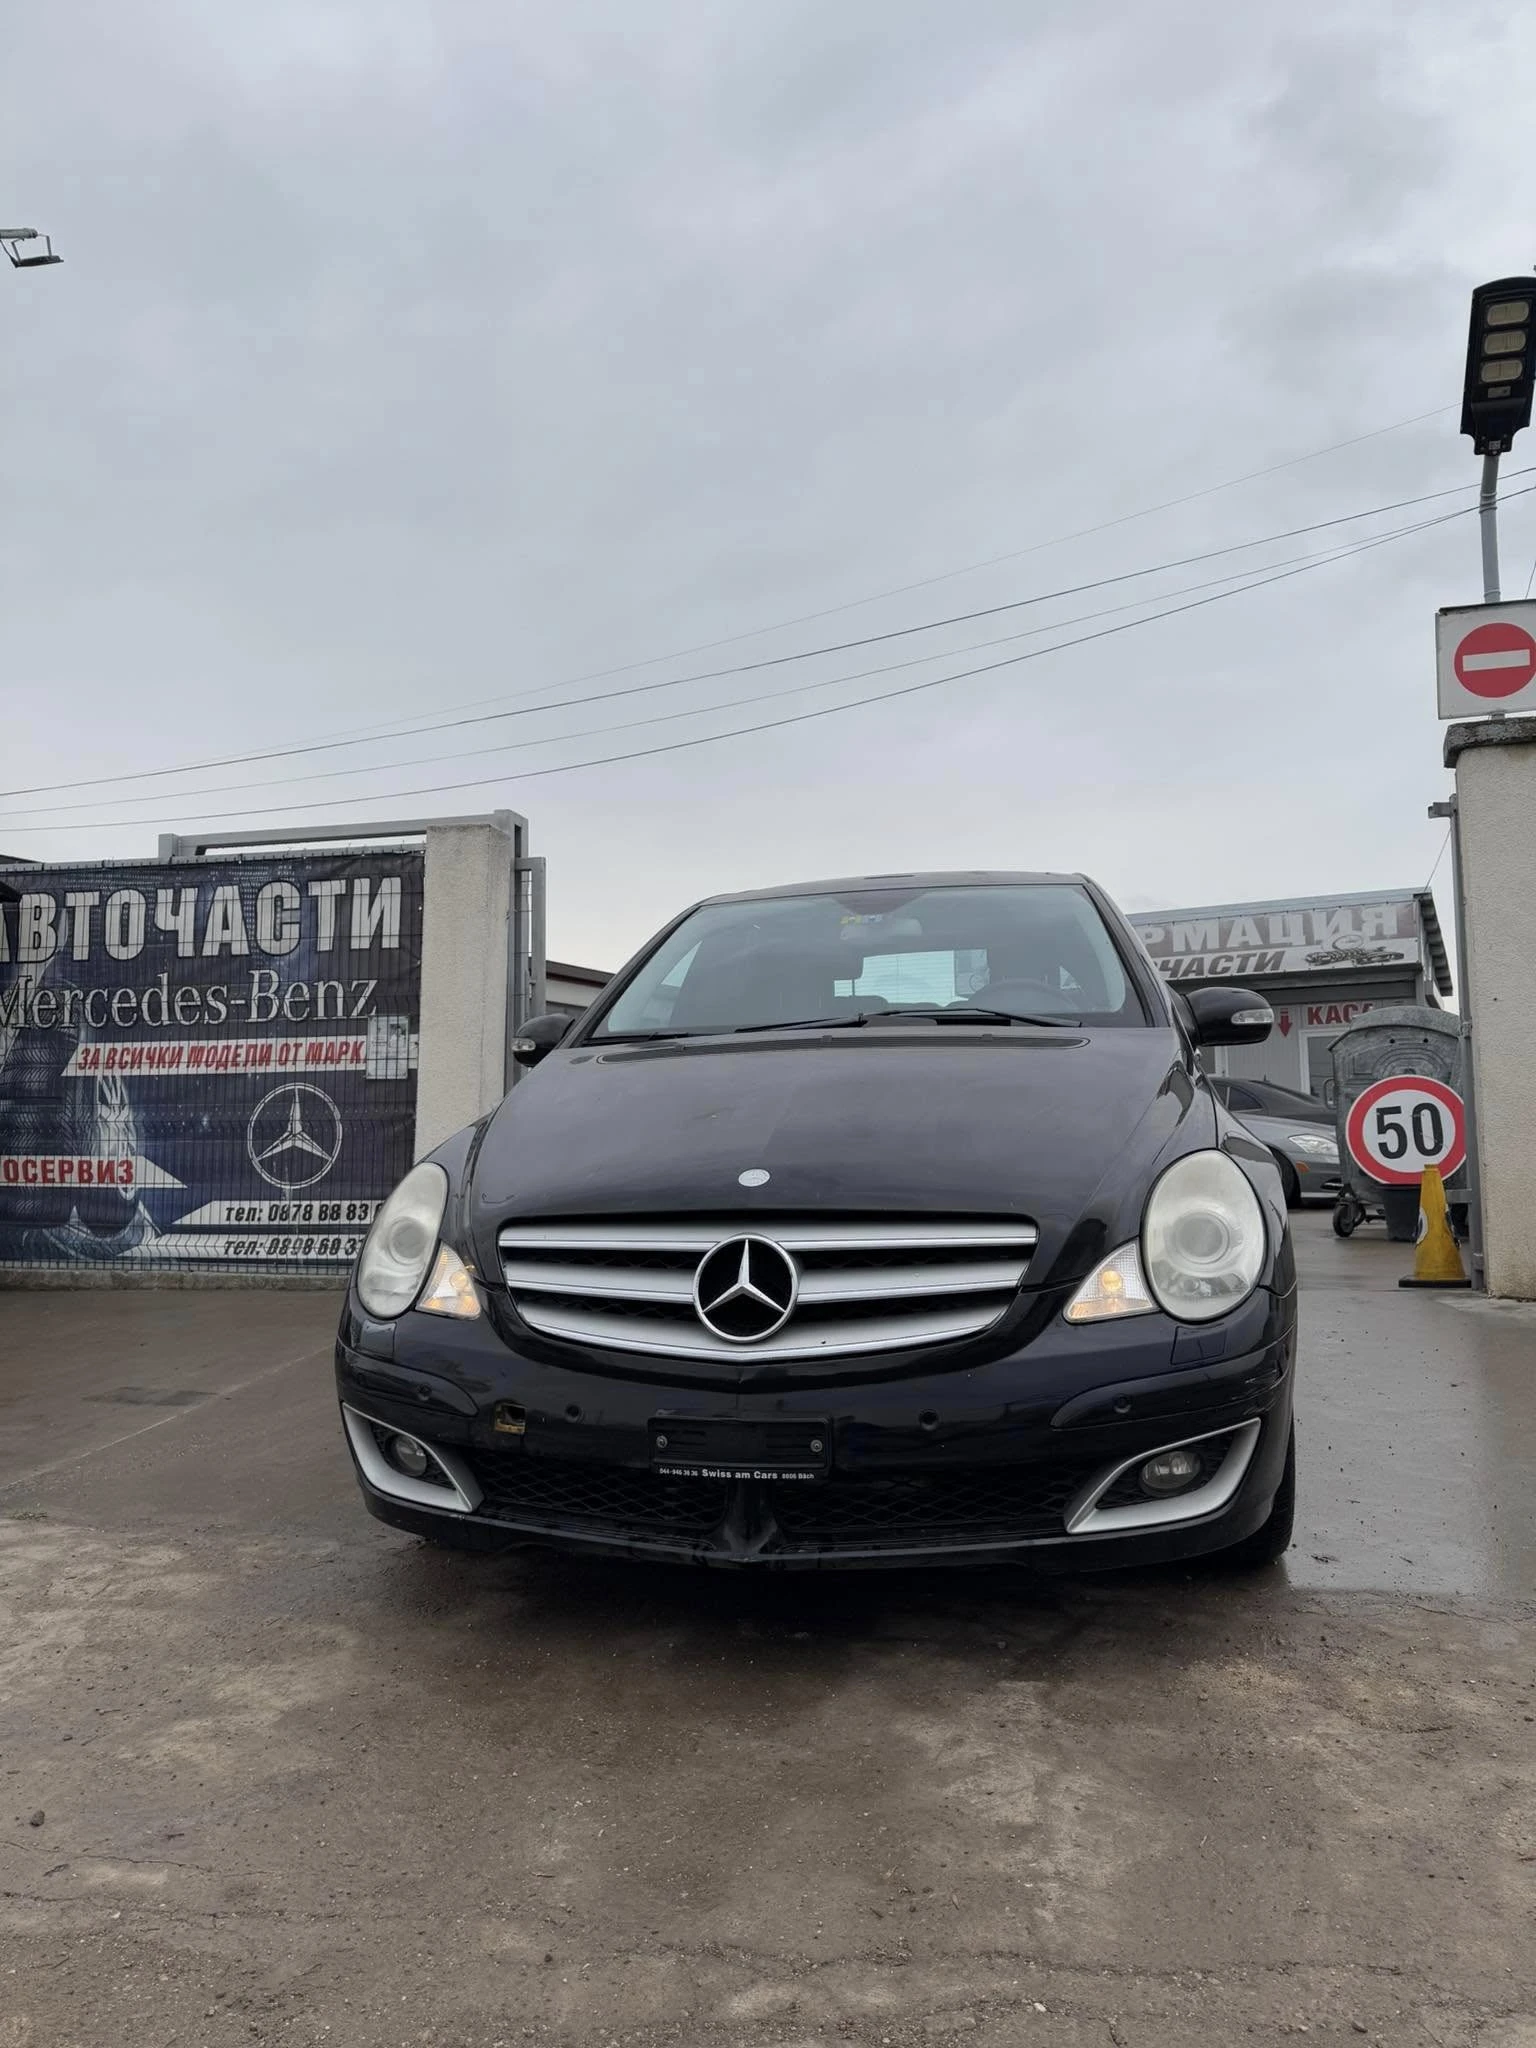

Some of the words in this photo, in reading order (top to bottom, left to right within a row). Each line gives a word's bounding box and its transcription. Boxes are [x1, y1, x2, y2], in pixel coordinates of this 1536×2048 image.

[0, 877, 401, 962] ВТОЧАСТИ
[1153, 950, 1286, 979] ЧАСТИ
[77, 1048, 99, 1071] ЗА
[104, 1045, 183, 1070] ВСИЧКИ
[187, 1042, 271, 1071] МОДЕЛИ
[278, 1042, 303, 1067] ОТ
[304, 1040, 367, 1066] МАРК
[1376, 1102, 1444, 1159] 50
[225, 1206, 263, 1222] тел:
[267, 1203, 313, 1222] 0878
[318, 1203, 341, 1221] 88
[345, 1202, 369, 1221] 83
[224, 1240, 264, 1256] тел:
[701, 1468, 732, 1479] Swiss
[735, 1471, 750, 1479] am
[753, 1471, 778, 1480] Cars
